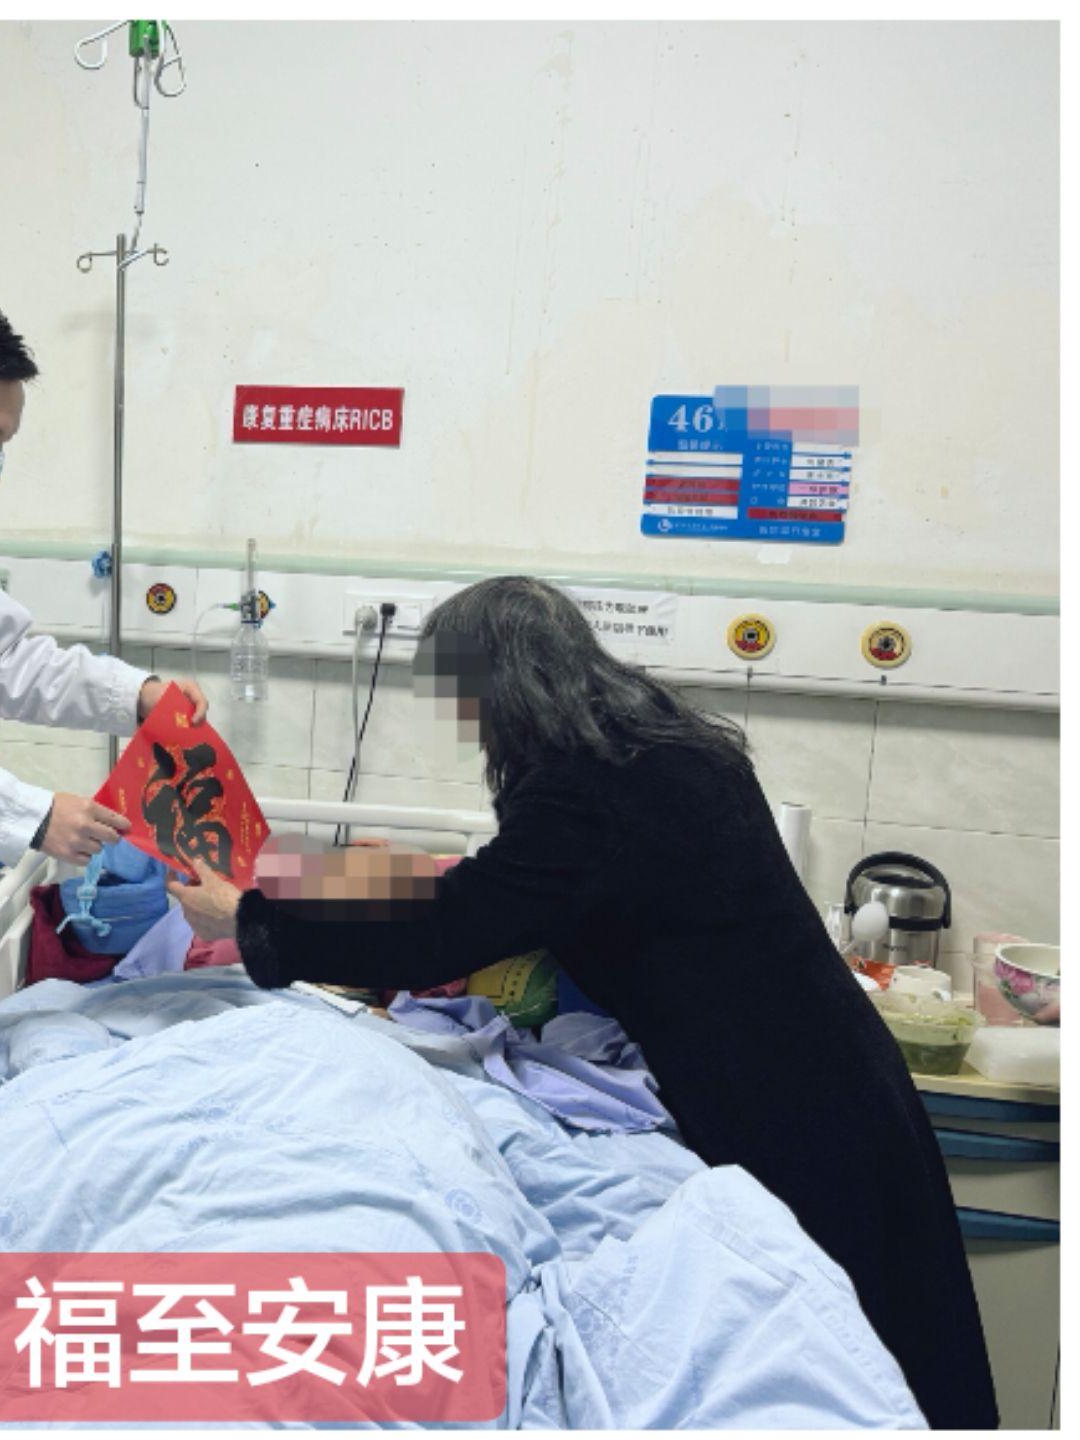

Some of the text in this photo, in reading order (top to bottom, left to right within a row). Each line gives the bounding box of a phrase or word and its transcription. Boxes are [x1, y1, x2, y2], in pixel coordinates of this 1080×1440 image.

[242, 403, 394, 432] 康复重症病床RICB
